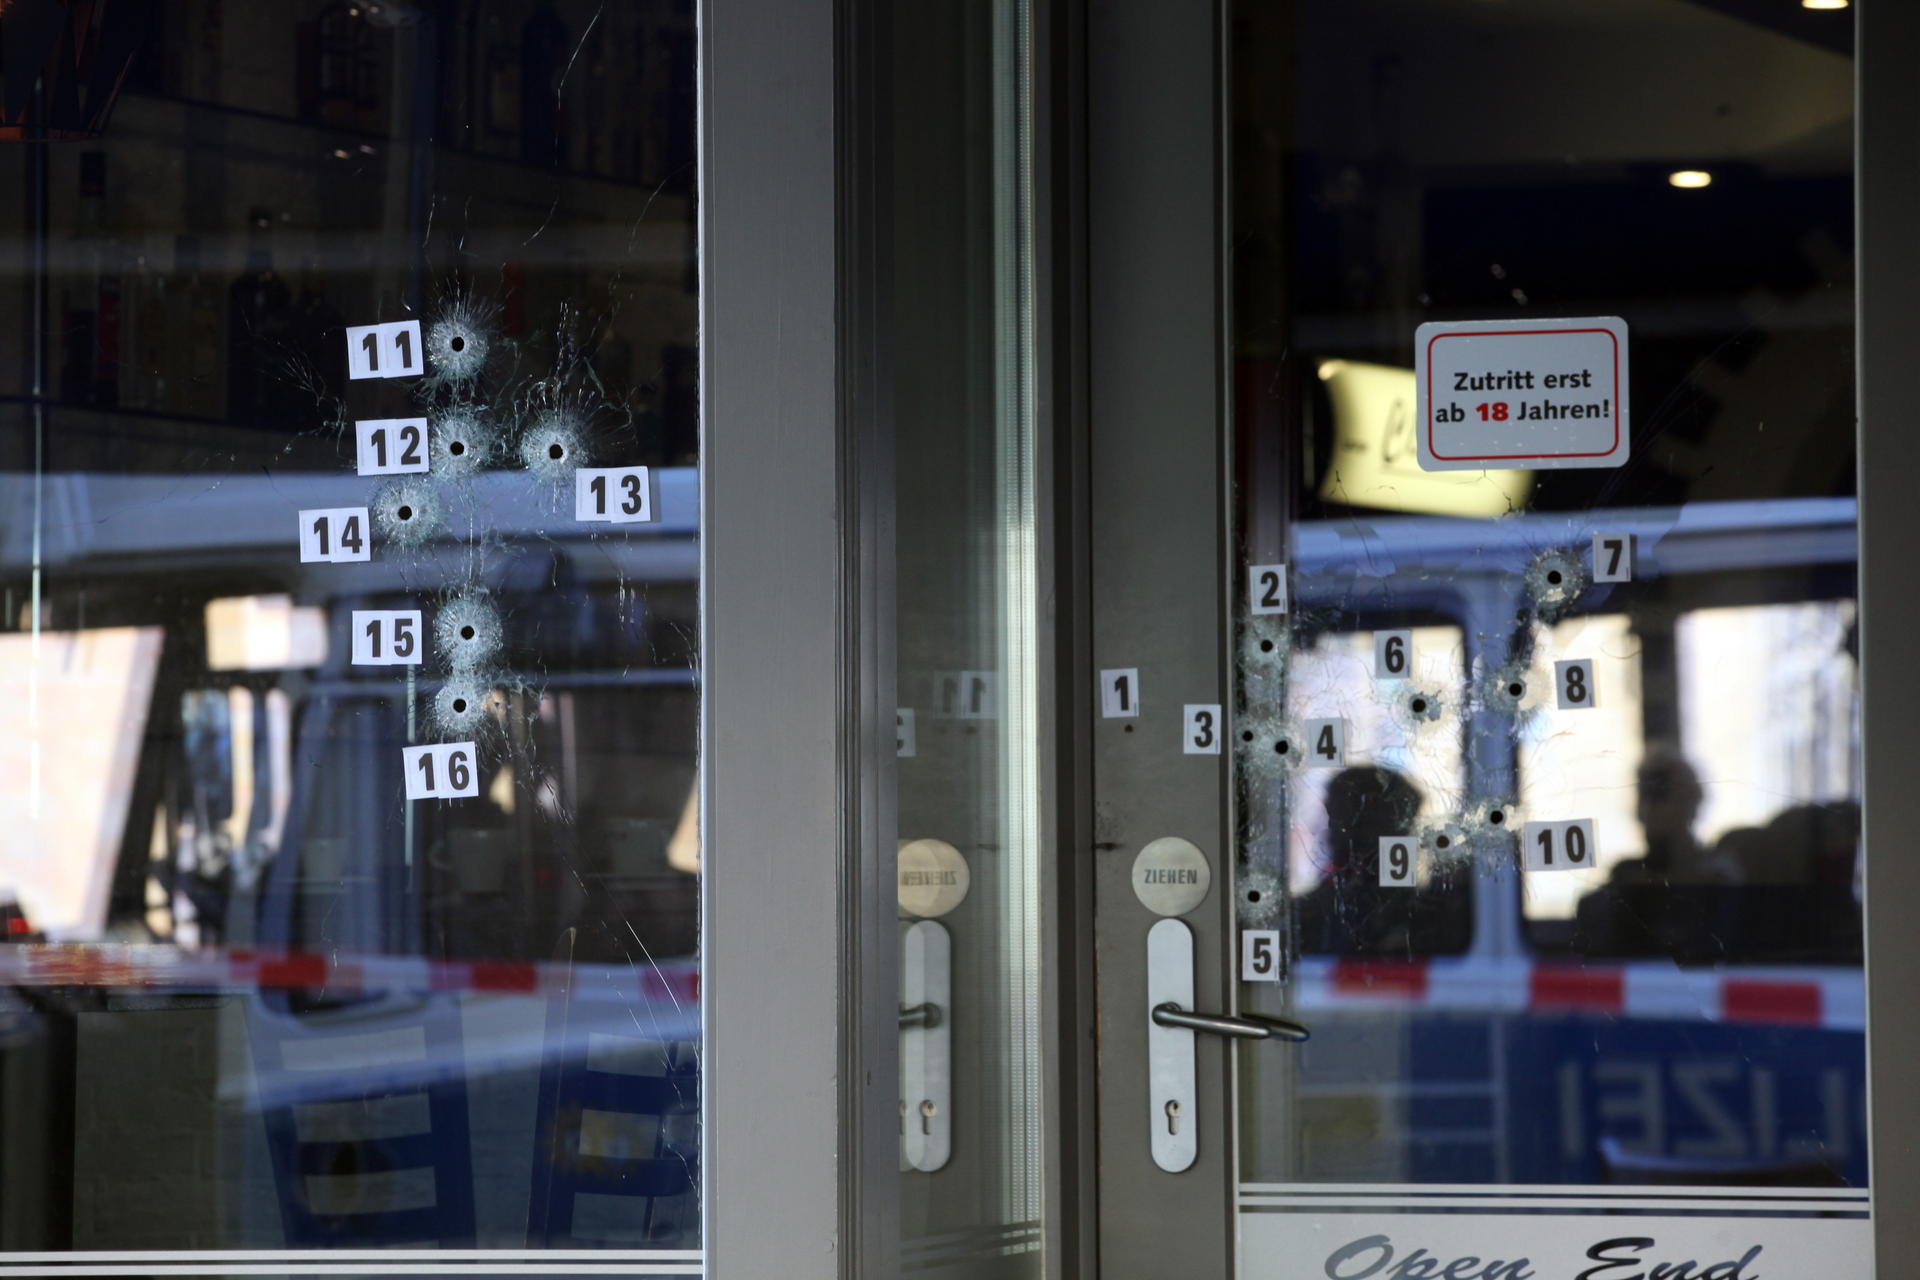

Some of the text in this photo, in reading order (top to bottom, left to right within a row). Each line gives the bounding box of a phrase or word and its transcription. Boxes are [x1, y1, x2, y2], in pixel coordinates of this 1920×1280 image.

[362, 330, 412, 371] 11
[1454, 369, 1592, 391] Zutritt erst
[1435, 399, 1610, 423] ab 18 Jahren!
[370, 424, 421, 467] 12
[590, 474, 642, 515] 13
[312, 515, 363, 555] 14
[1602, 539, 1622, 576] 7
[1260, 571, 1280, 607] 2
[366, 618, 414, 658] 15
[1384, 636, 1405, 673] 6
[1114, 675, 1129, 712] 1
[1565, 665, 1587, 703] 8
[1194, 711, 1213, 748] 3
[1316, 724, 1337, 760] 4
[418, 750, 470, 791] 16
[1389, 842, 1409, 880] 9
[1537, 825, 1586, 866] 10
[1143, 868, 1198, 884] ZIEHEN
[1252, 937, 1272, 975] 5
[1324, 1234, 1764, 1280] Open End
